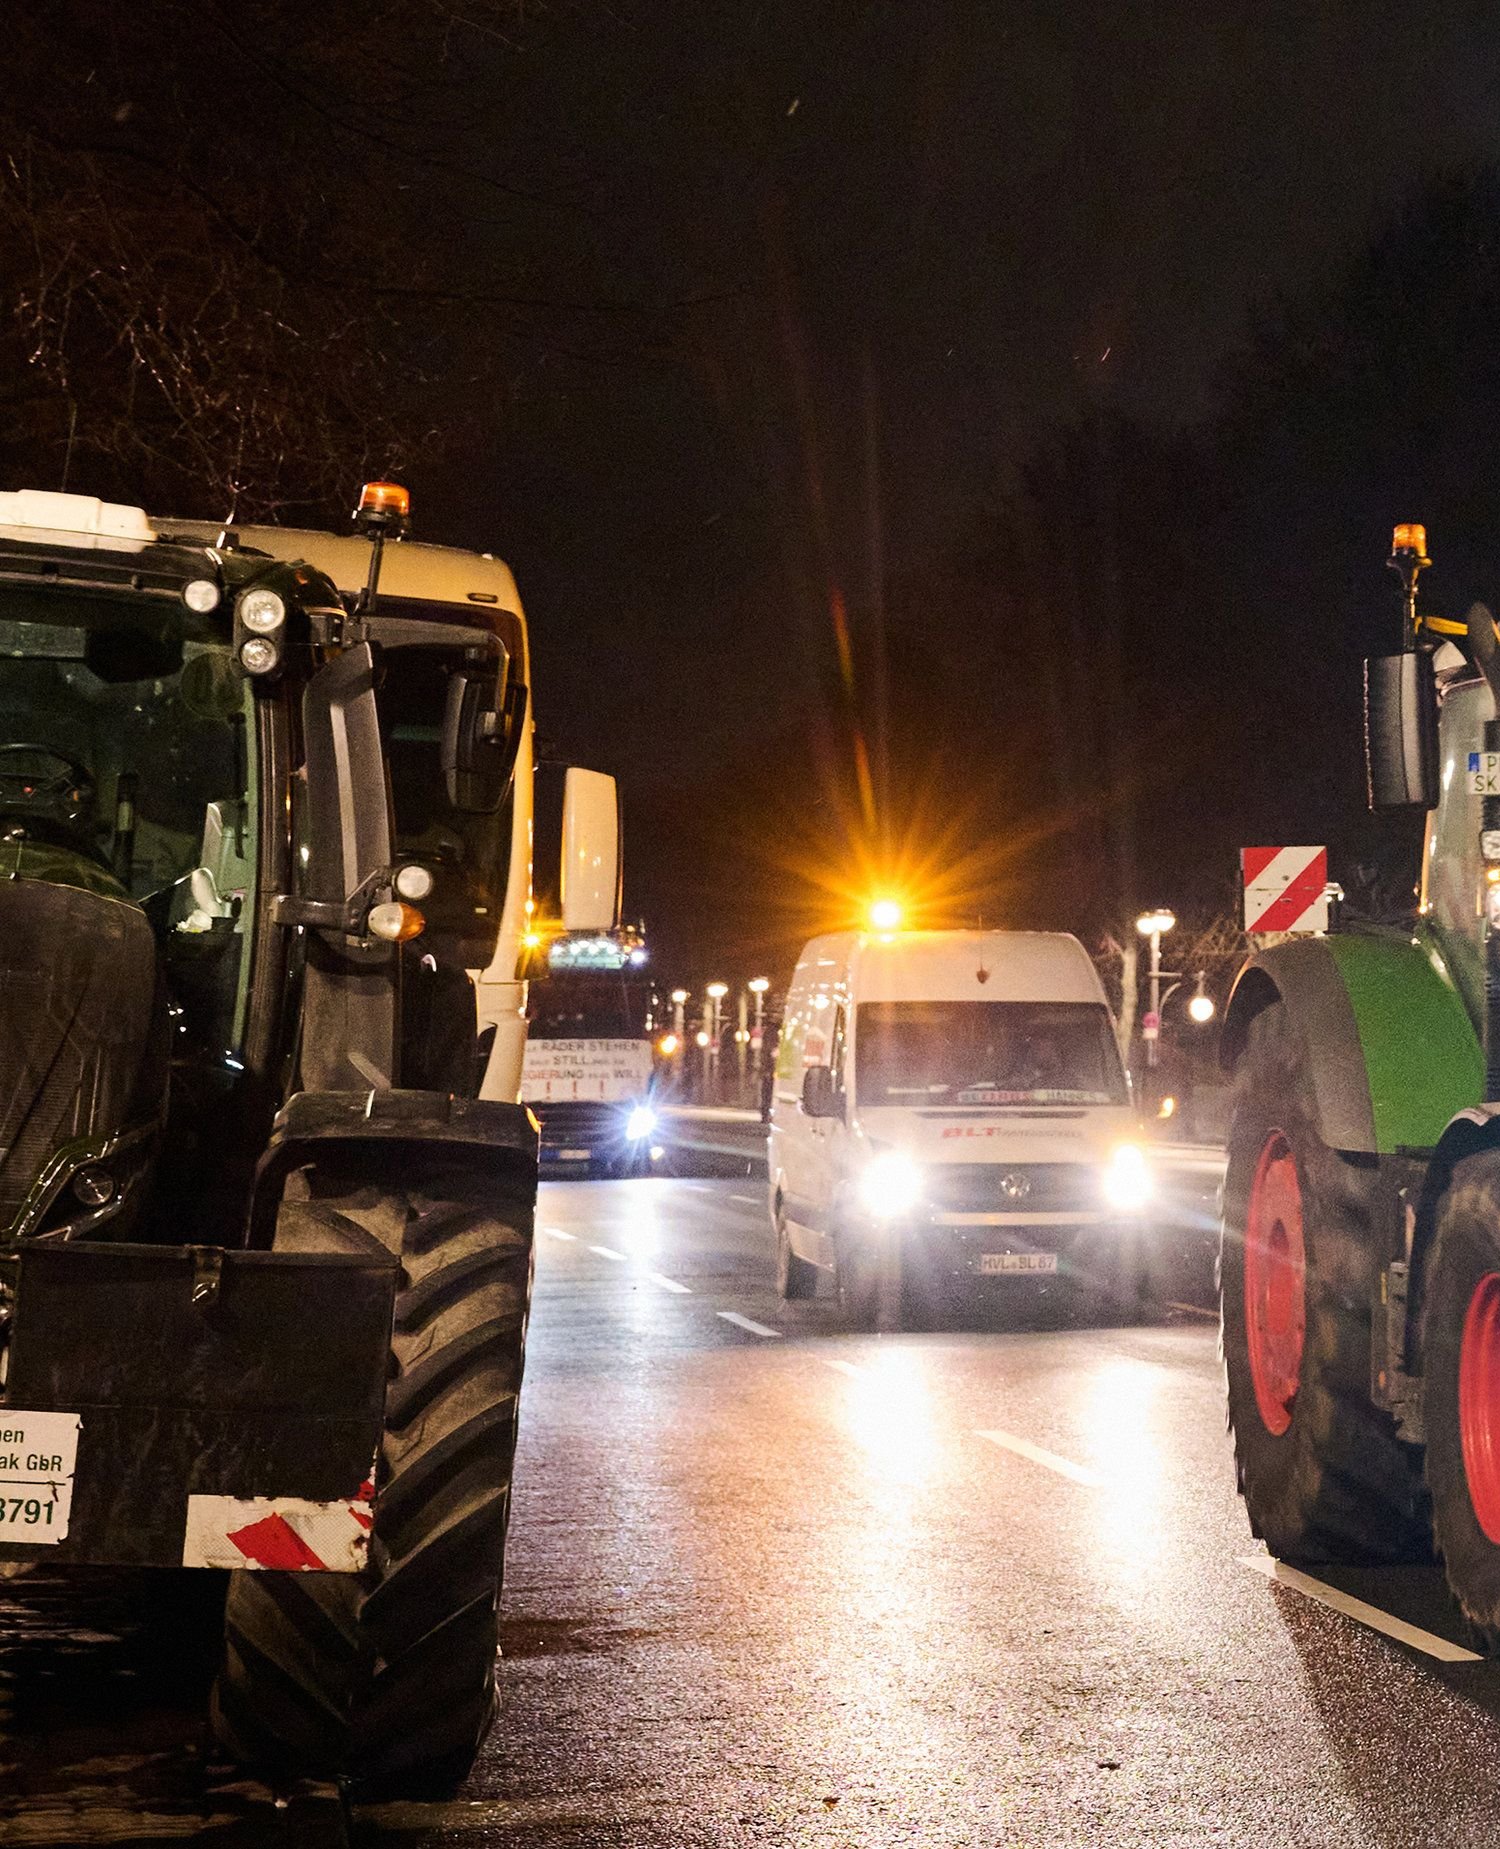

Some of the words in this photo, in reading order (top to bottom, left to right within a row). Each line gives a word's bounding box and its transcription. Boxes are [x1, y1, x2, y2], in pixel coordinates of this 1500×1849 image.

[1474, 774, 1497, 792] SK
[589, 1041, 639, 1051] STEHEN
[0, 1429, 24, 1443] en
[26, 1453, 62, 1472] GbR
